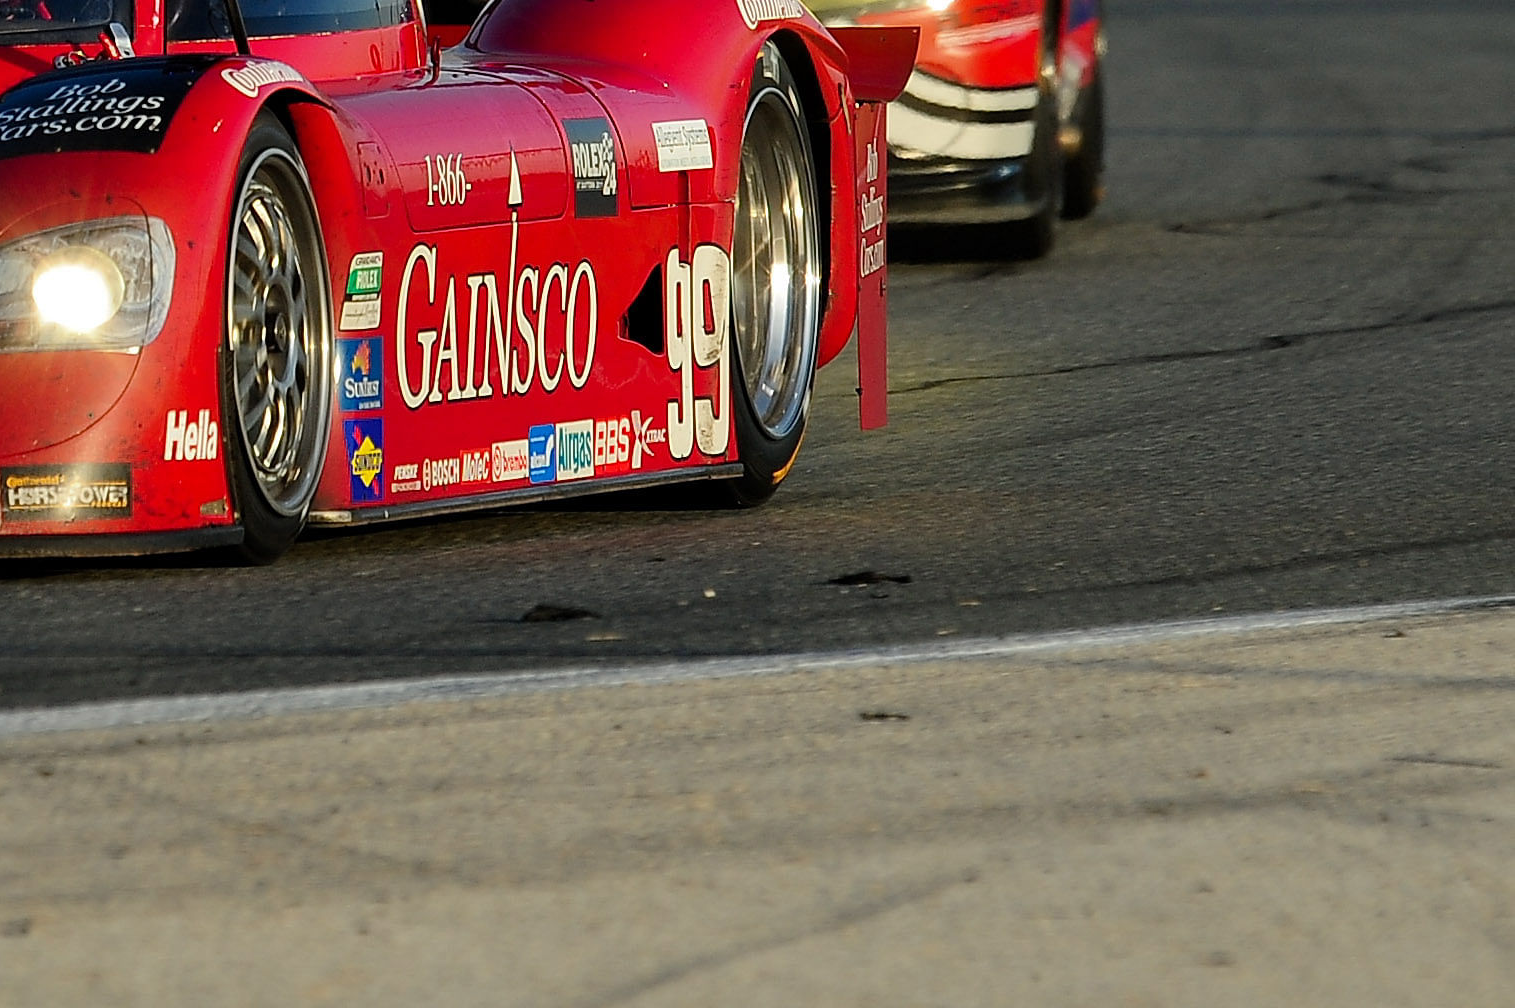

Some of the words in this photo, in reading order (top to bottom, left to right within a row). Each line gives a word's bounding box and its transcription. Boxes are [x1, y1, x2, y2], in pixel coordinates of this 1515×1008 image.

[45, 78, 127, 101] Bob
[425, 153, 472, 206] 1-866-
[572, 142, 604, 179] ROLEX
[603, 161, 617, 196] 24
[396, 244, 598, 409] GAINSCO
[666, 245, 731, 459] 99
[163, 409, 219, 462] Hella
[558, 427, 593, 475] Airgas
[595, 417, 631, 467] BBS
[393, 464, 419, 480] PENSKE
[431, 457, 460, 487] BOSCH
[462, 451, 491, 482] MoTeC
